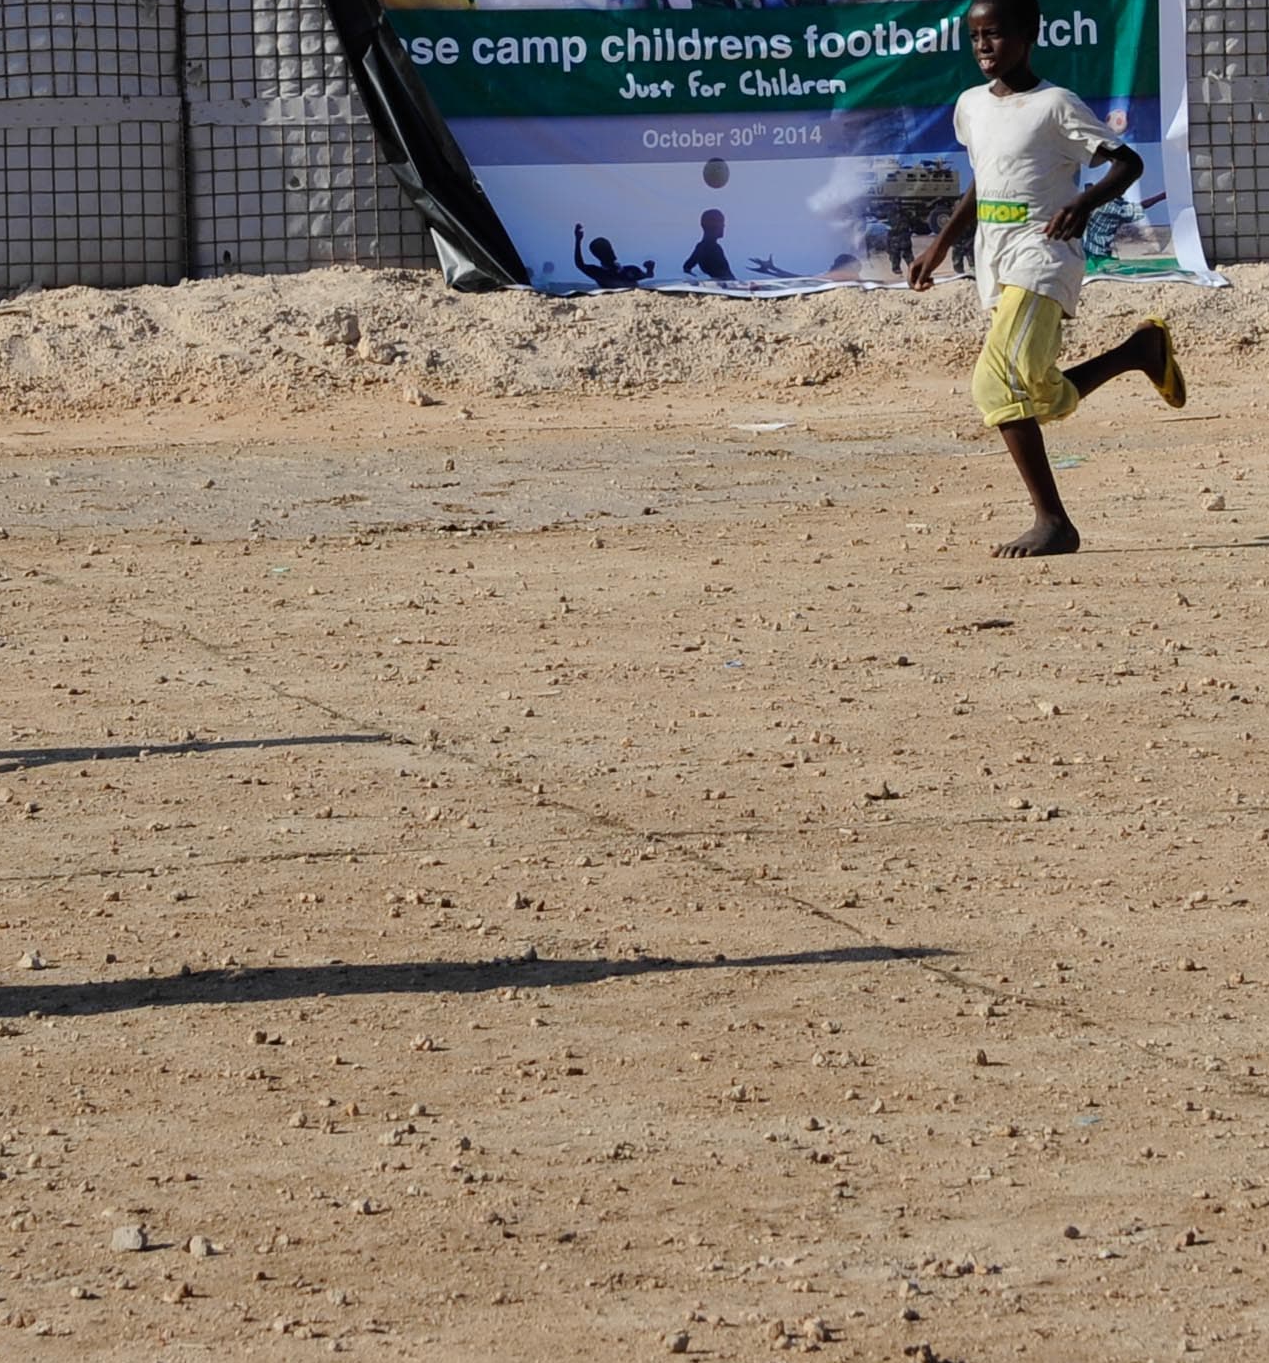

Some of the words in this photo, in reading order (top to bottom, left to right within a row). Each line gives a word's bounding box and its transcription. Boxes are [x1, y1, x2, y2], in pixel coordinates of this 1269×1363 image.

[398, 36, 460, 65] se
[472, 37, 587, 73] camp
[601, 27, 793, 62] childrens
[804, 16, 961, 59] football
[1037, 10, 1098, 48] tch
[619, 72, 674, 99] Just
[739, 67, 847, 97] Children
[642, 128, 724, 148] October
[730, 122, 767, 147] 30th
[773, 125, 823, 146] 2014
